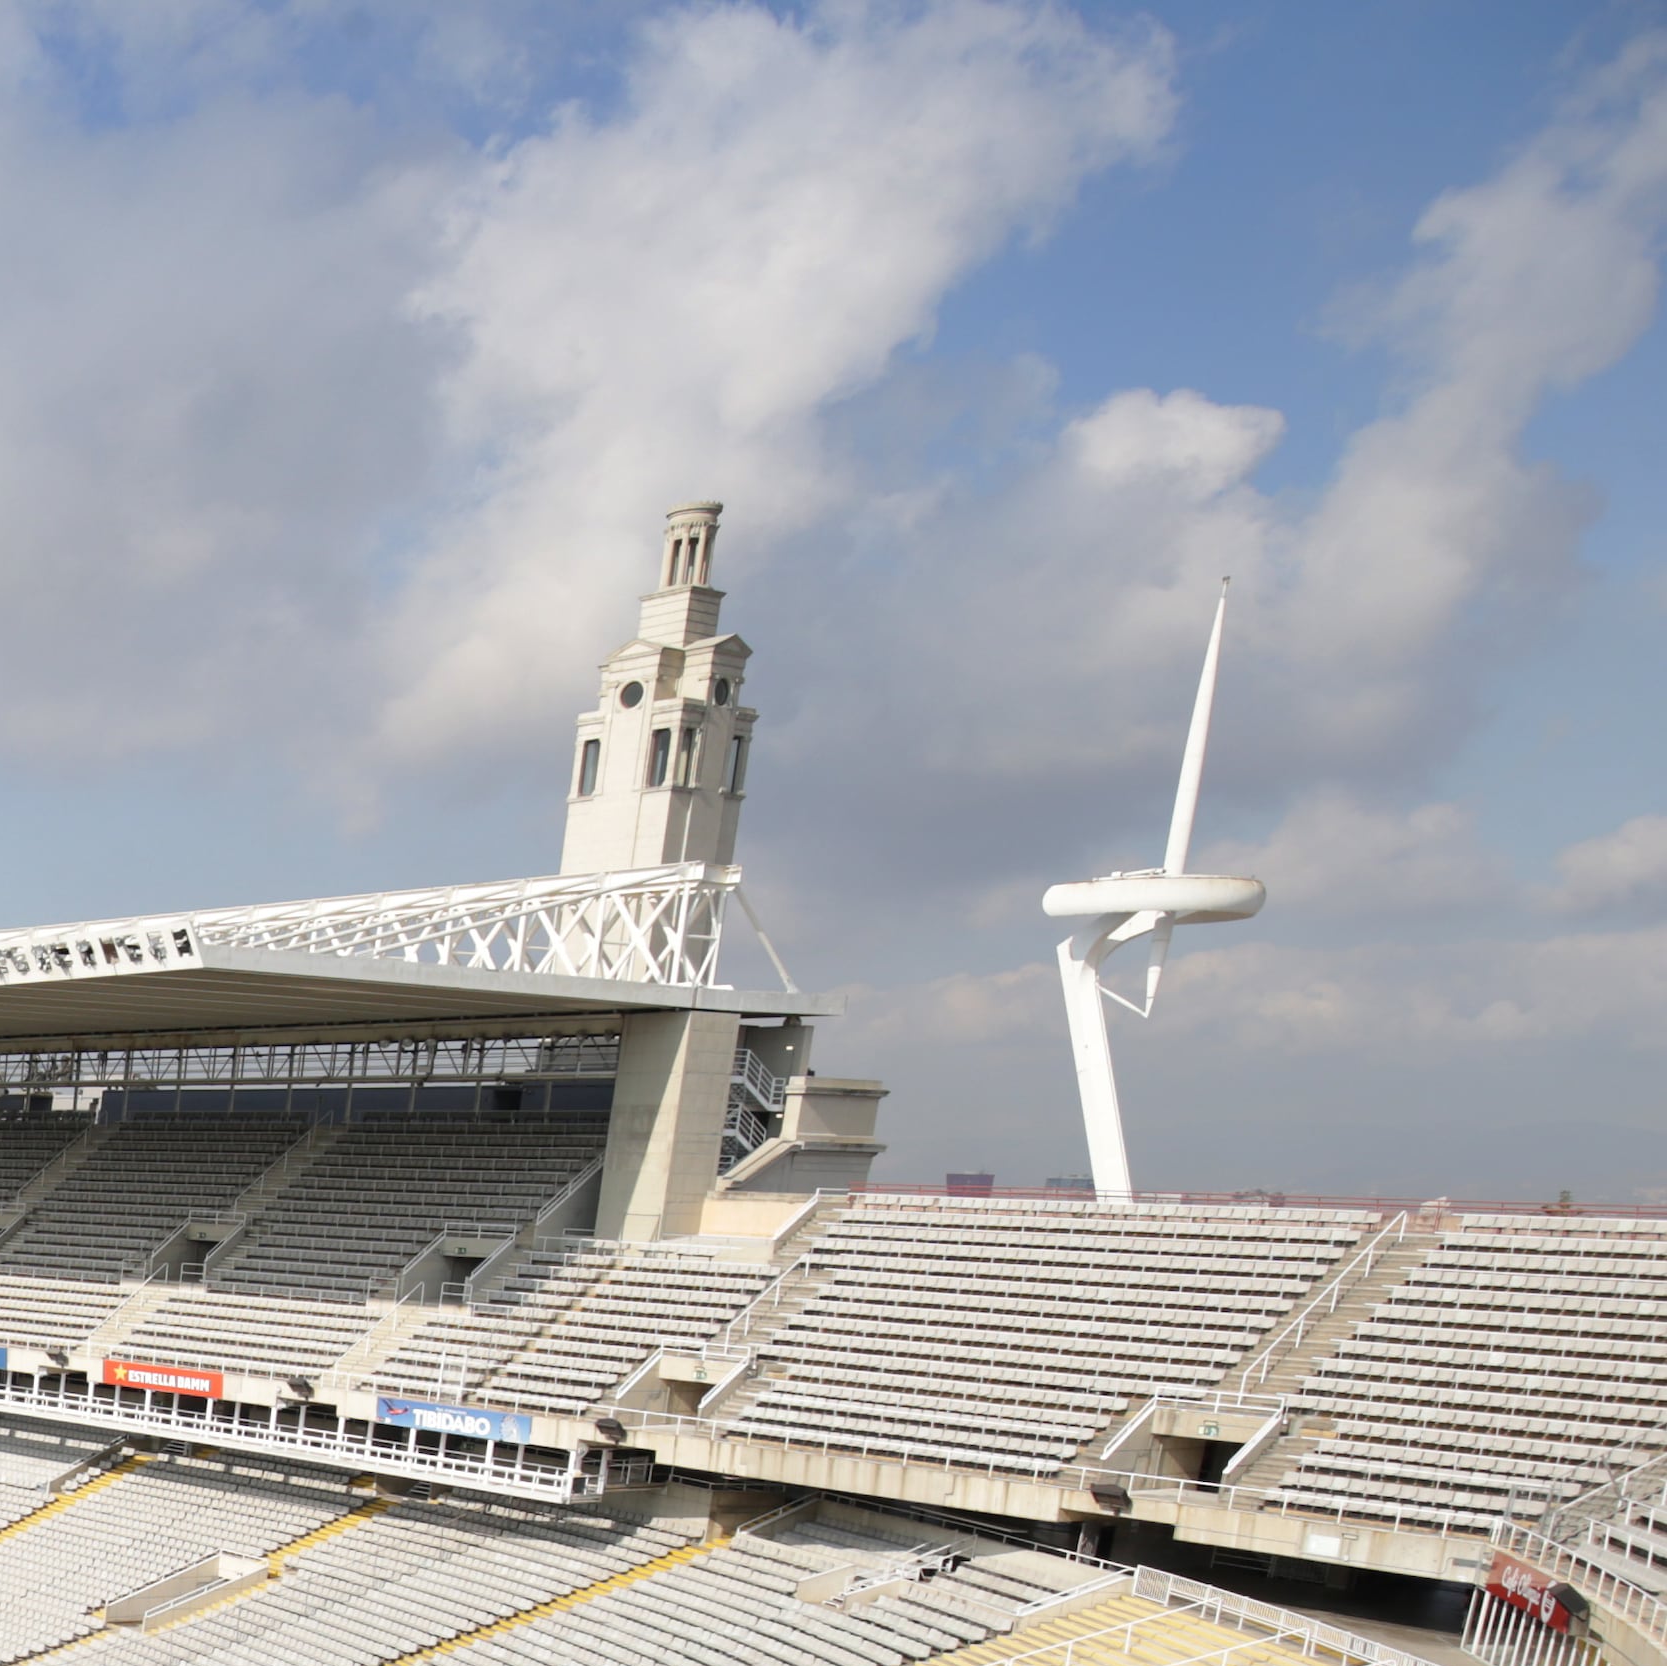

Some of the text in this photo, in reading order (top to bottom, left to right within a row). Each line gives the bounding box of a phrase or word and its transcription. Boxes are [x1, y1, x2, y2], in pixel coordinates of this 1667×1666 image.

[128, 1370, 211, 1392] ESTRELLA DAMM
[413, 1409, 491, 1436] TIBIDABO
